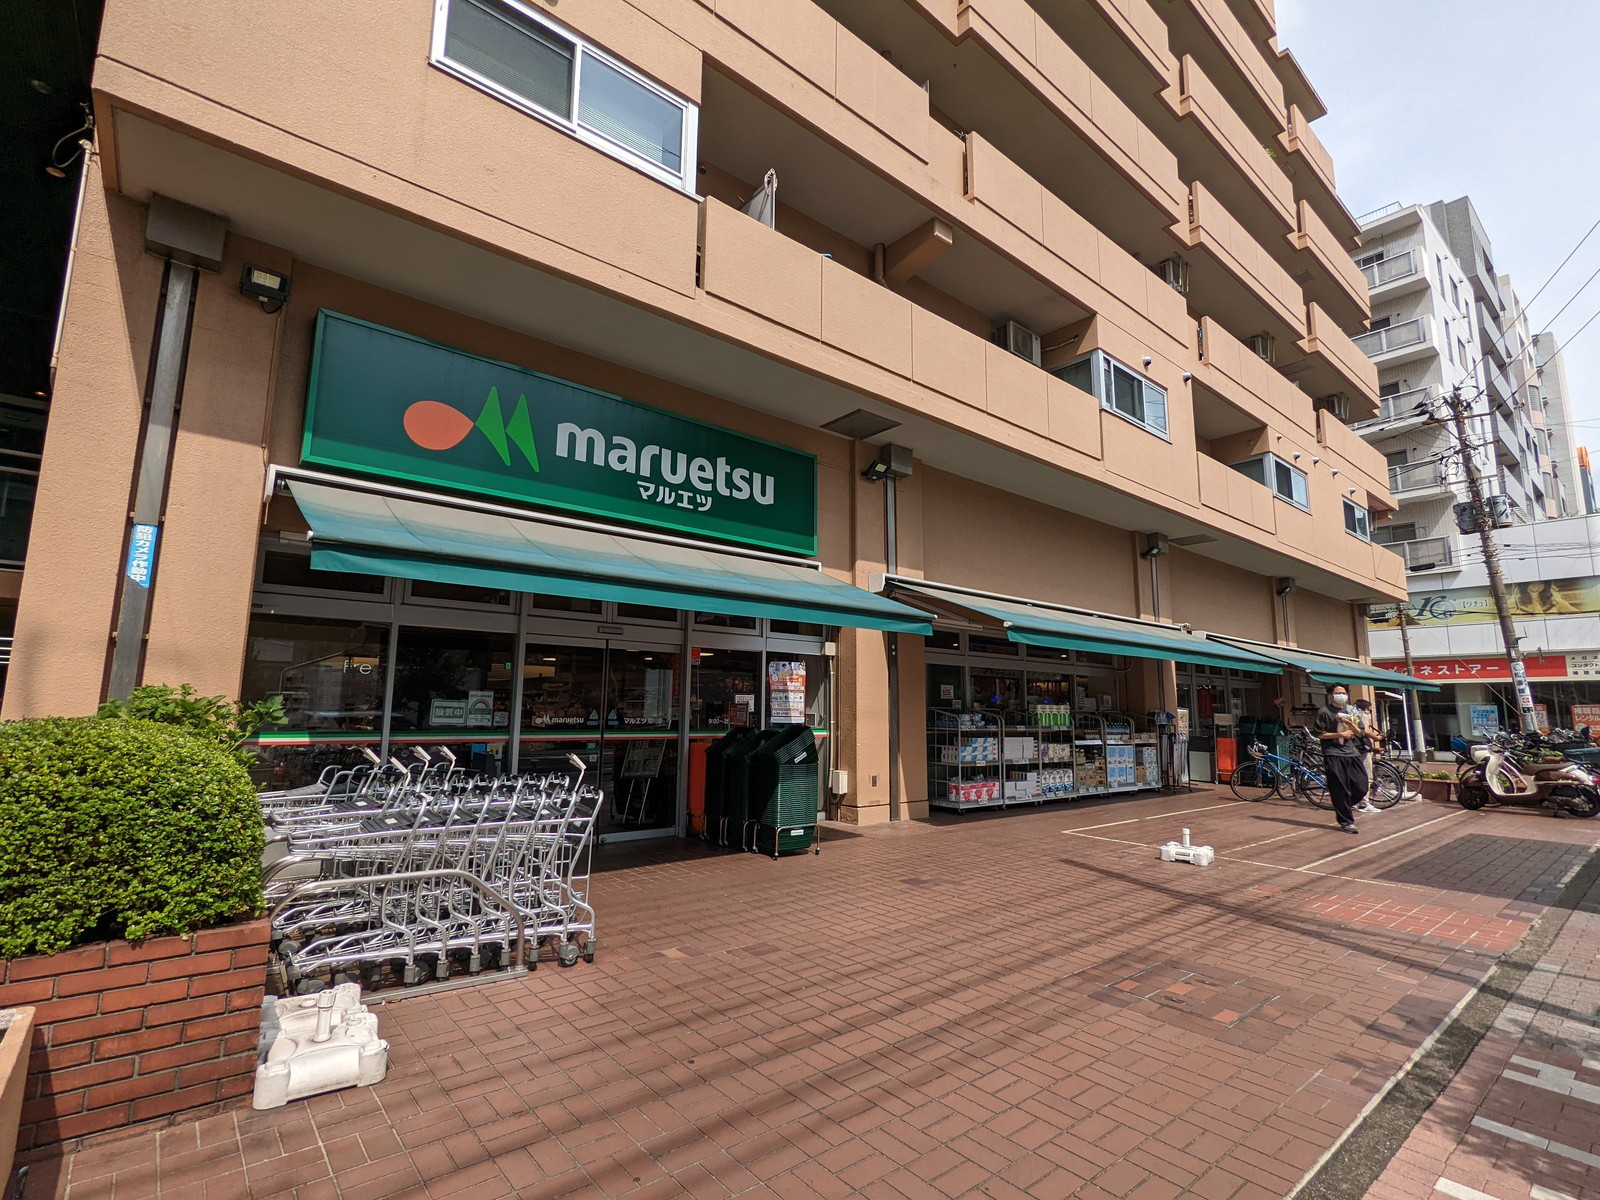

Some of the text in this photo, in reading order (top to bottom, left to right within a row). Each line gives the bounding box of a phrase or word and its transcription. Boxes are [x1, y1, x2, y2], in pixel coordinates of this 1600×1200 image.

[555, 422, 775, 505] maruetsu
[636, 480, 713, 512] マルエツ
[131, 525, 153, 581] 防犯カメラ作動中
